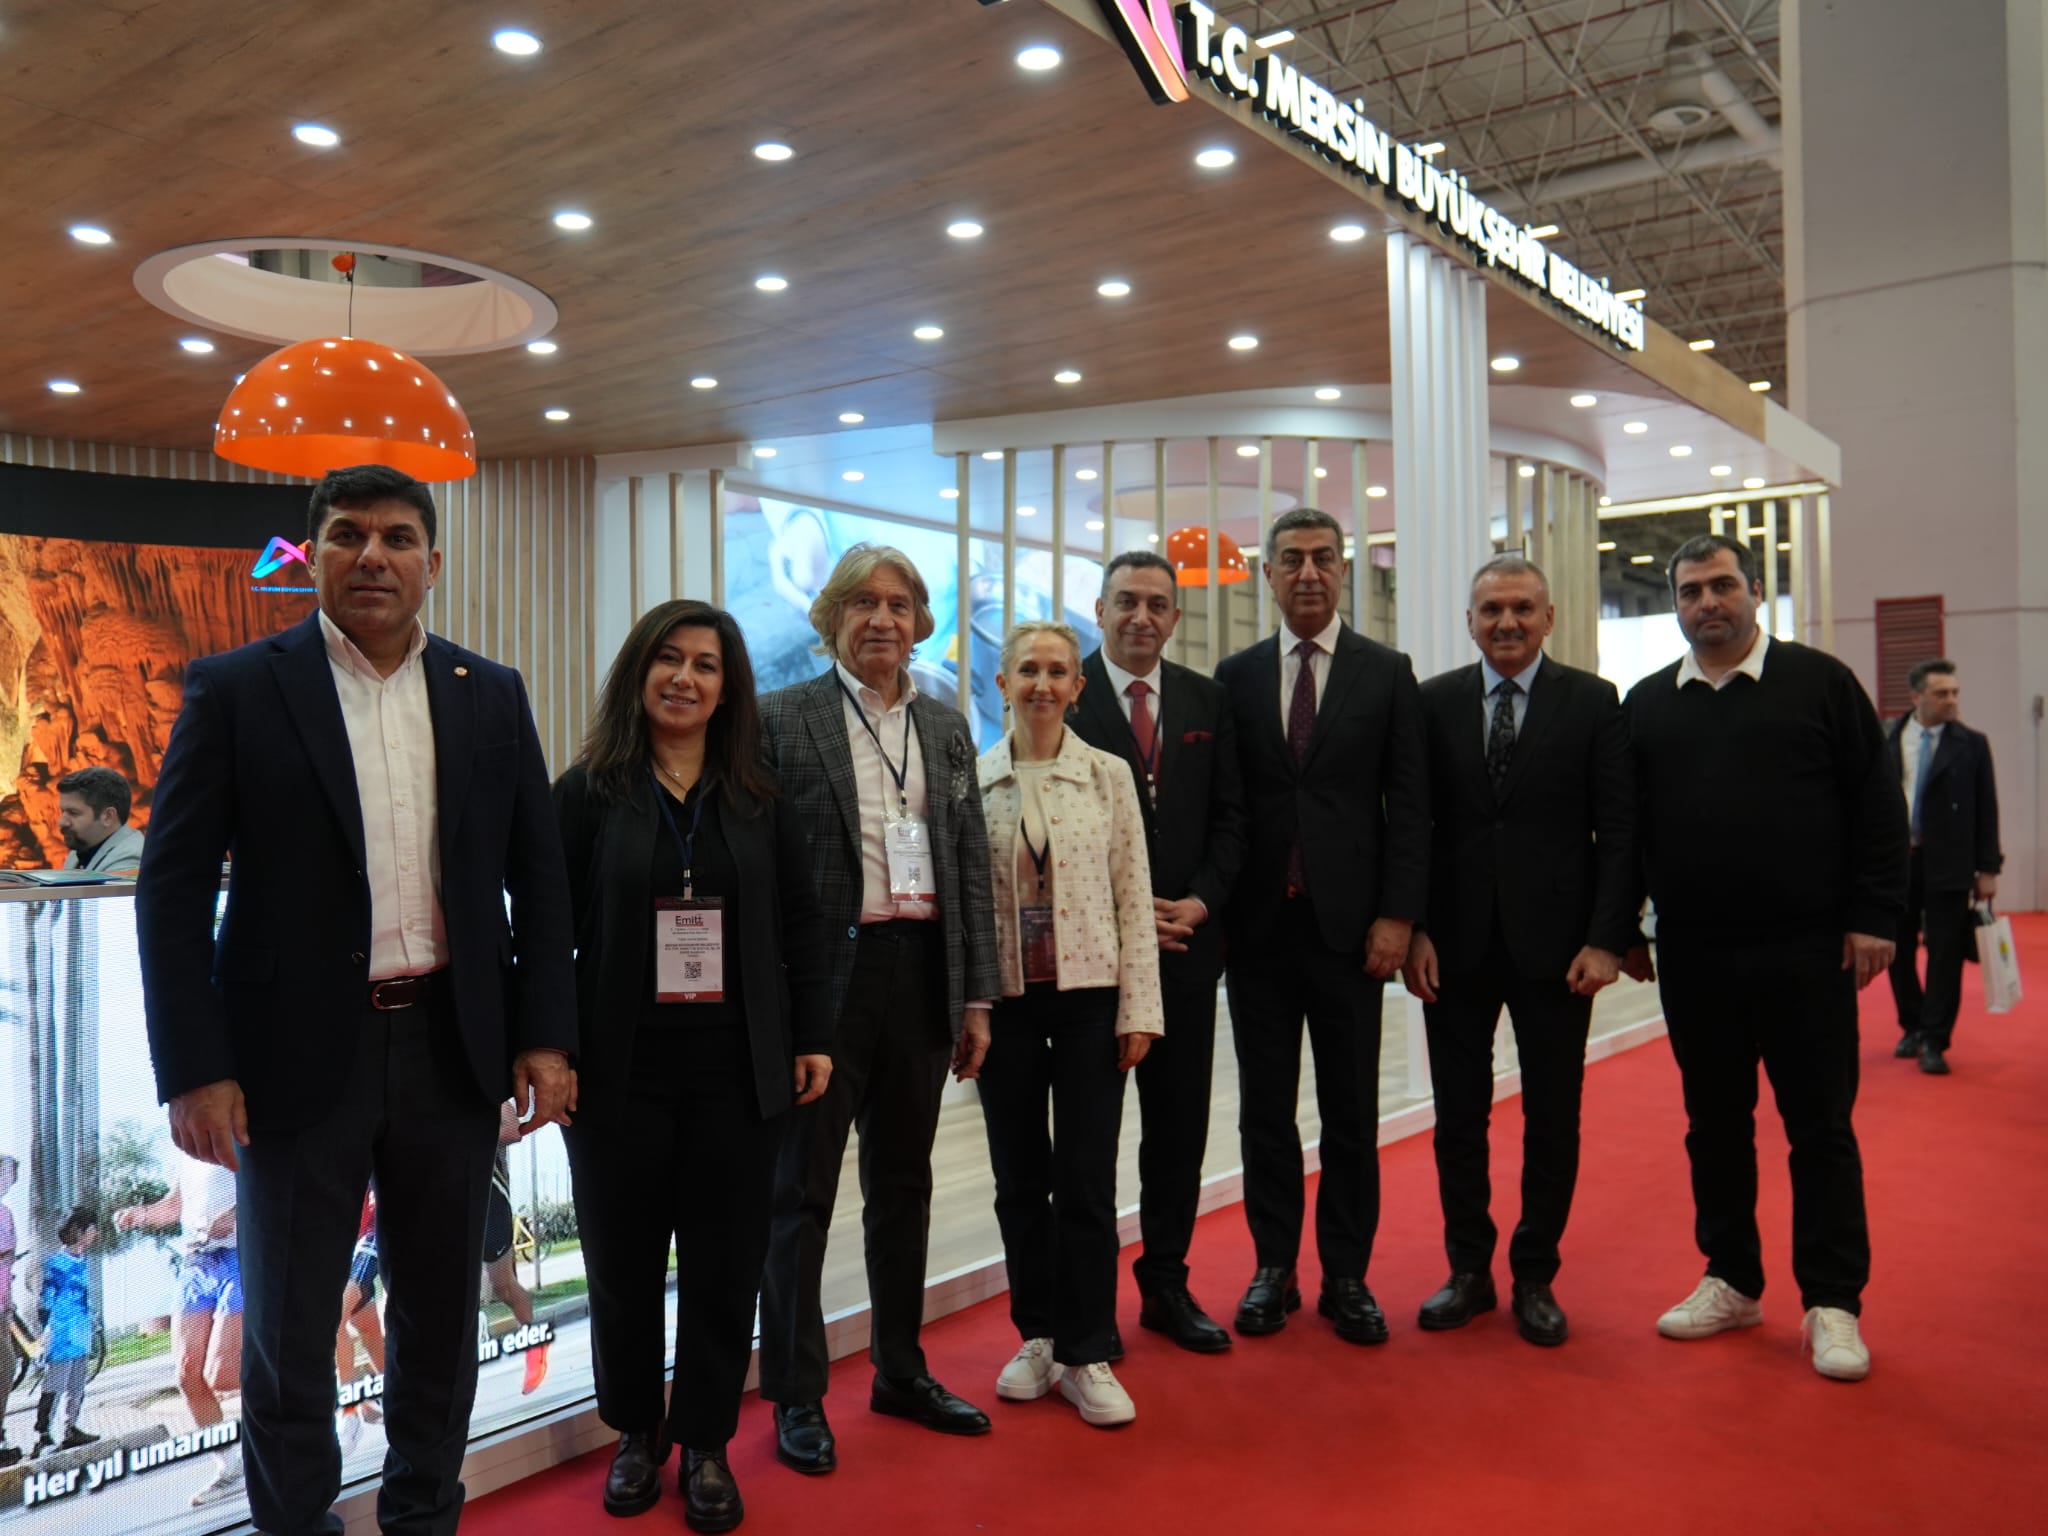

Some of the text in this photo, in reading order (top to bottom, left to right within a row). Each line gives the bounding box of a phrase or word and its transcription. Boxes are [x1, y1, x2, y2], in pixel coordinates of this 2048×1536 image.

[1190, 0, 1645, 352] T.C. MERSİN BÜYÜKŞEHİR BELEDİYESİ
[675, 915, 704, 925] Emitt
[24, 1467, 79, 1506] Her
[87, 1450, 124, 1490] yıl
[129, 1420, 239, 1472] umarım
[502, 1322, 553, 1353] eder.
